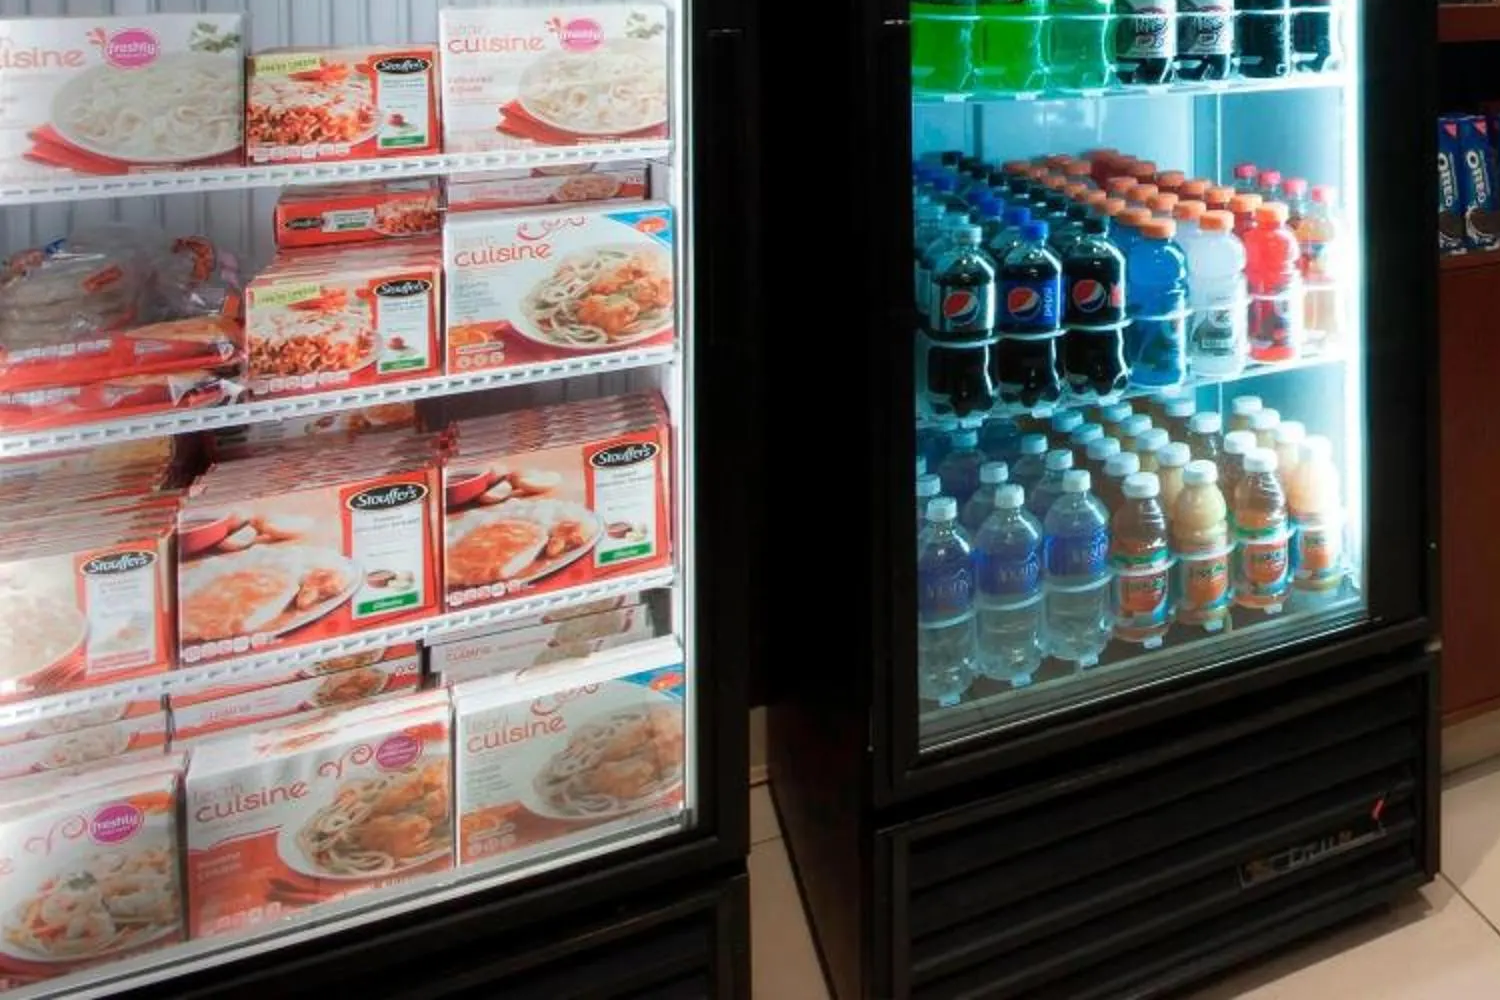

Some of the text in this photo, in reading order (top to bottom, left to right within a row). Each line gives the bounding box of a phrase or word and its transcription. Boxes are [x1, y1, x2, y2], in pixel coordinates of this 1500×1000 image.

[446, 34, 546, 54] cuisine
[0, 47, 87, 69] isine
[453, 241, 553, 268] cuisine
[355, 485, 418, 508] Stouffer's
[467, 716, 568, 754] cuisine
[194, 780, 310, 824] cuisine
